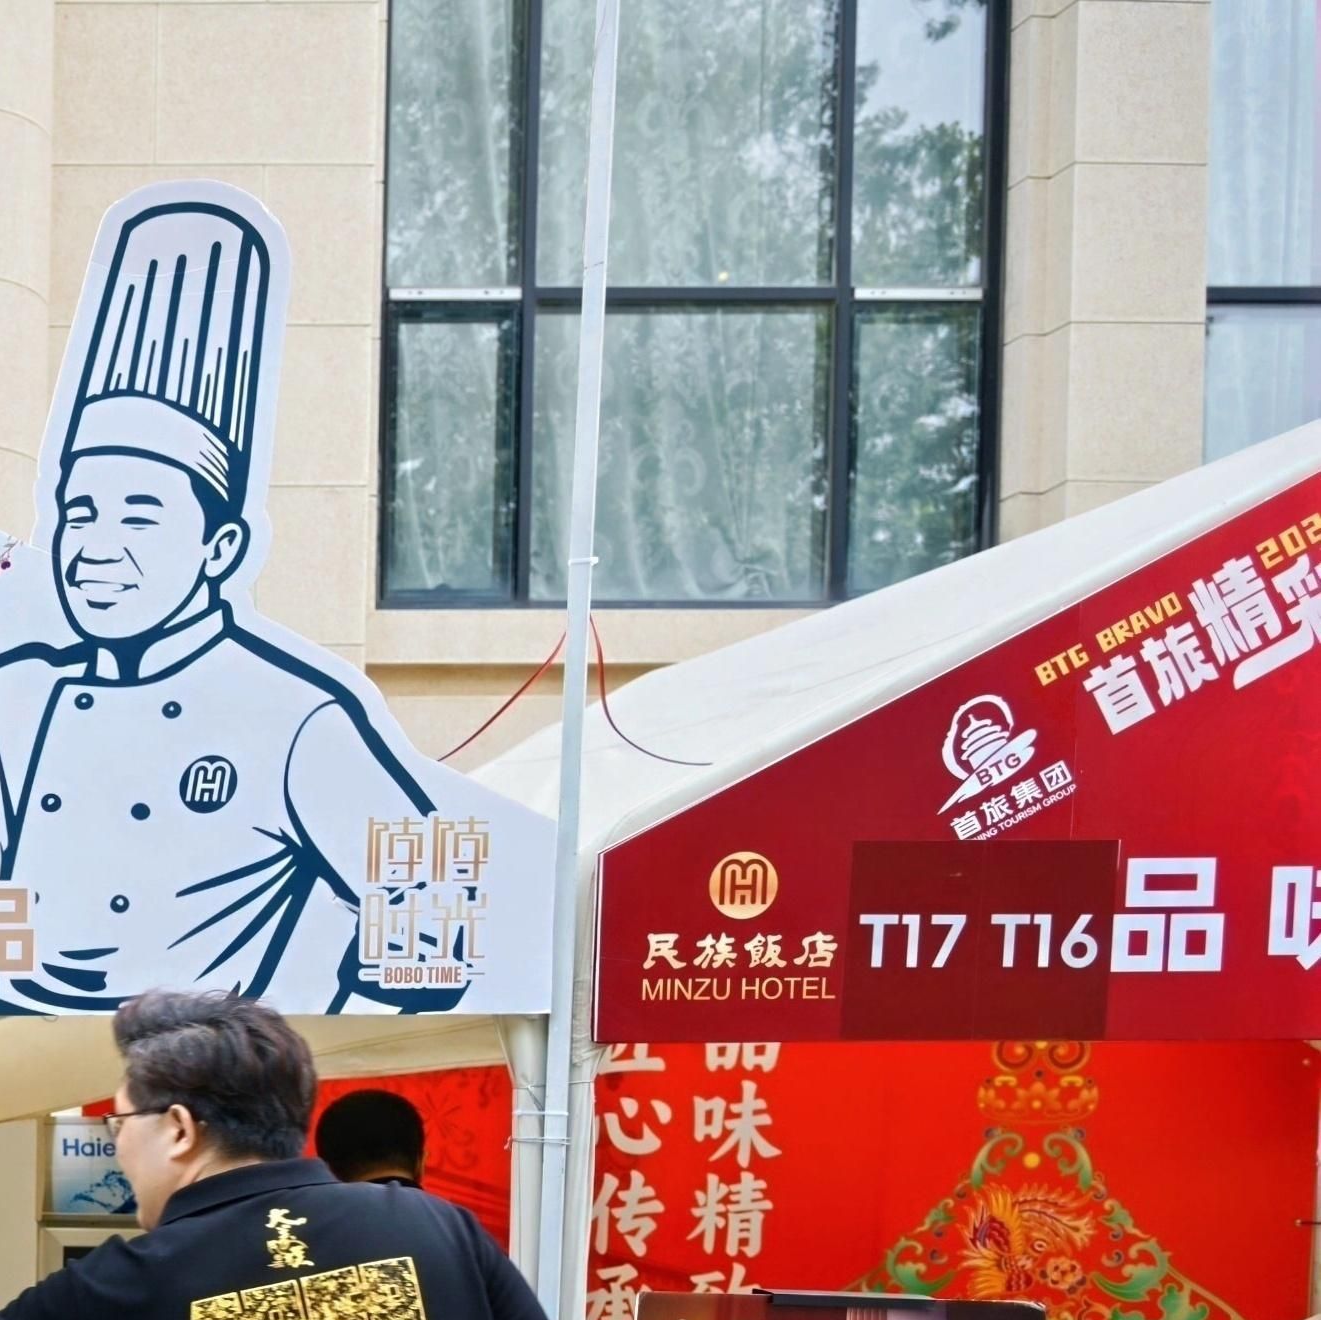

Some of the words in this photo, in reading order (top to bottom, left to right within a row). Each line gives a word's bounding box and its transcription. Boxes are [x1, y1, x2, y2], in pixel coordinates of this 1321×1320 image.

[1035, 643, 1090, 687] BTG
[1095, 591, 1184, 654] BRAVO
[975, 752, 1022, 787] BTG
[950, 759, 1073, 841] 首旅集团
[998, 805, 1042, 831] TOURISM
[1042, 783, 1077, 808] GROUP
[363, 892, 488, 960] 时光
[860, 913, 967, 969] T17
[991, 913, 1100, 969] T16
[384, 966, 423, 984] BOBO
[426, 966, 462, 984] TIME
[640, 978, 731, 1001] MINZU
[740, 976, 836, 1001] HOTEL
